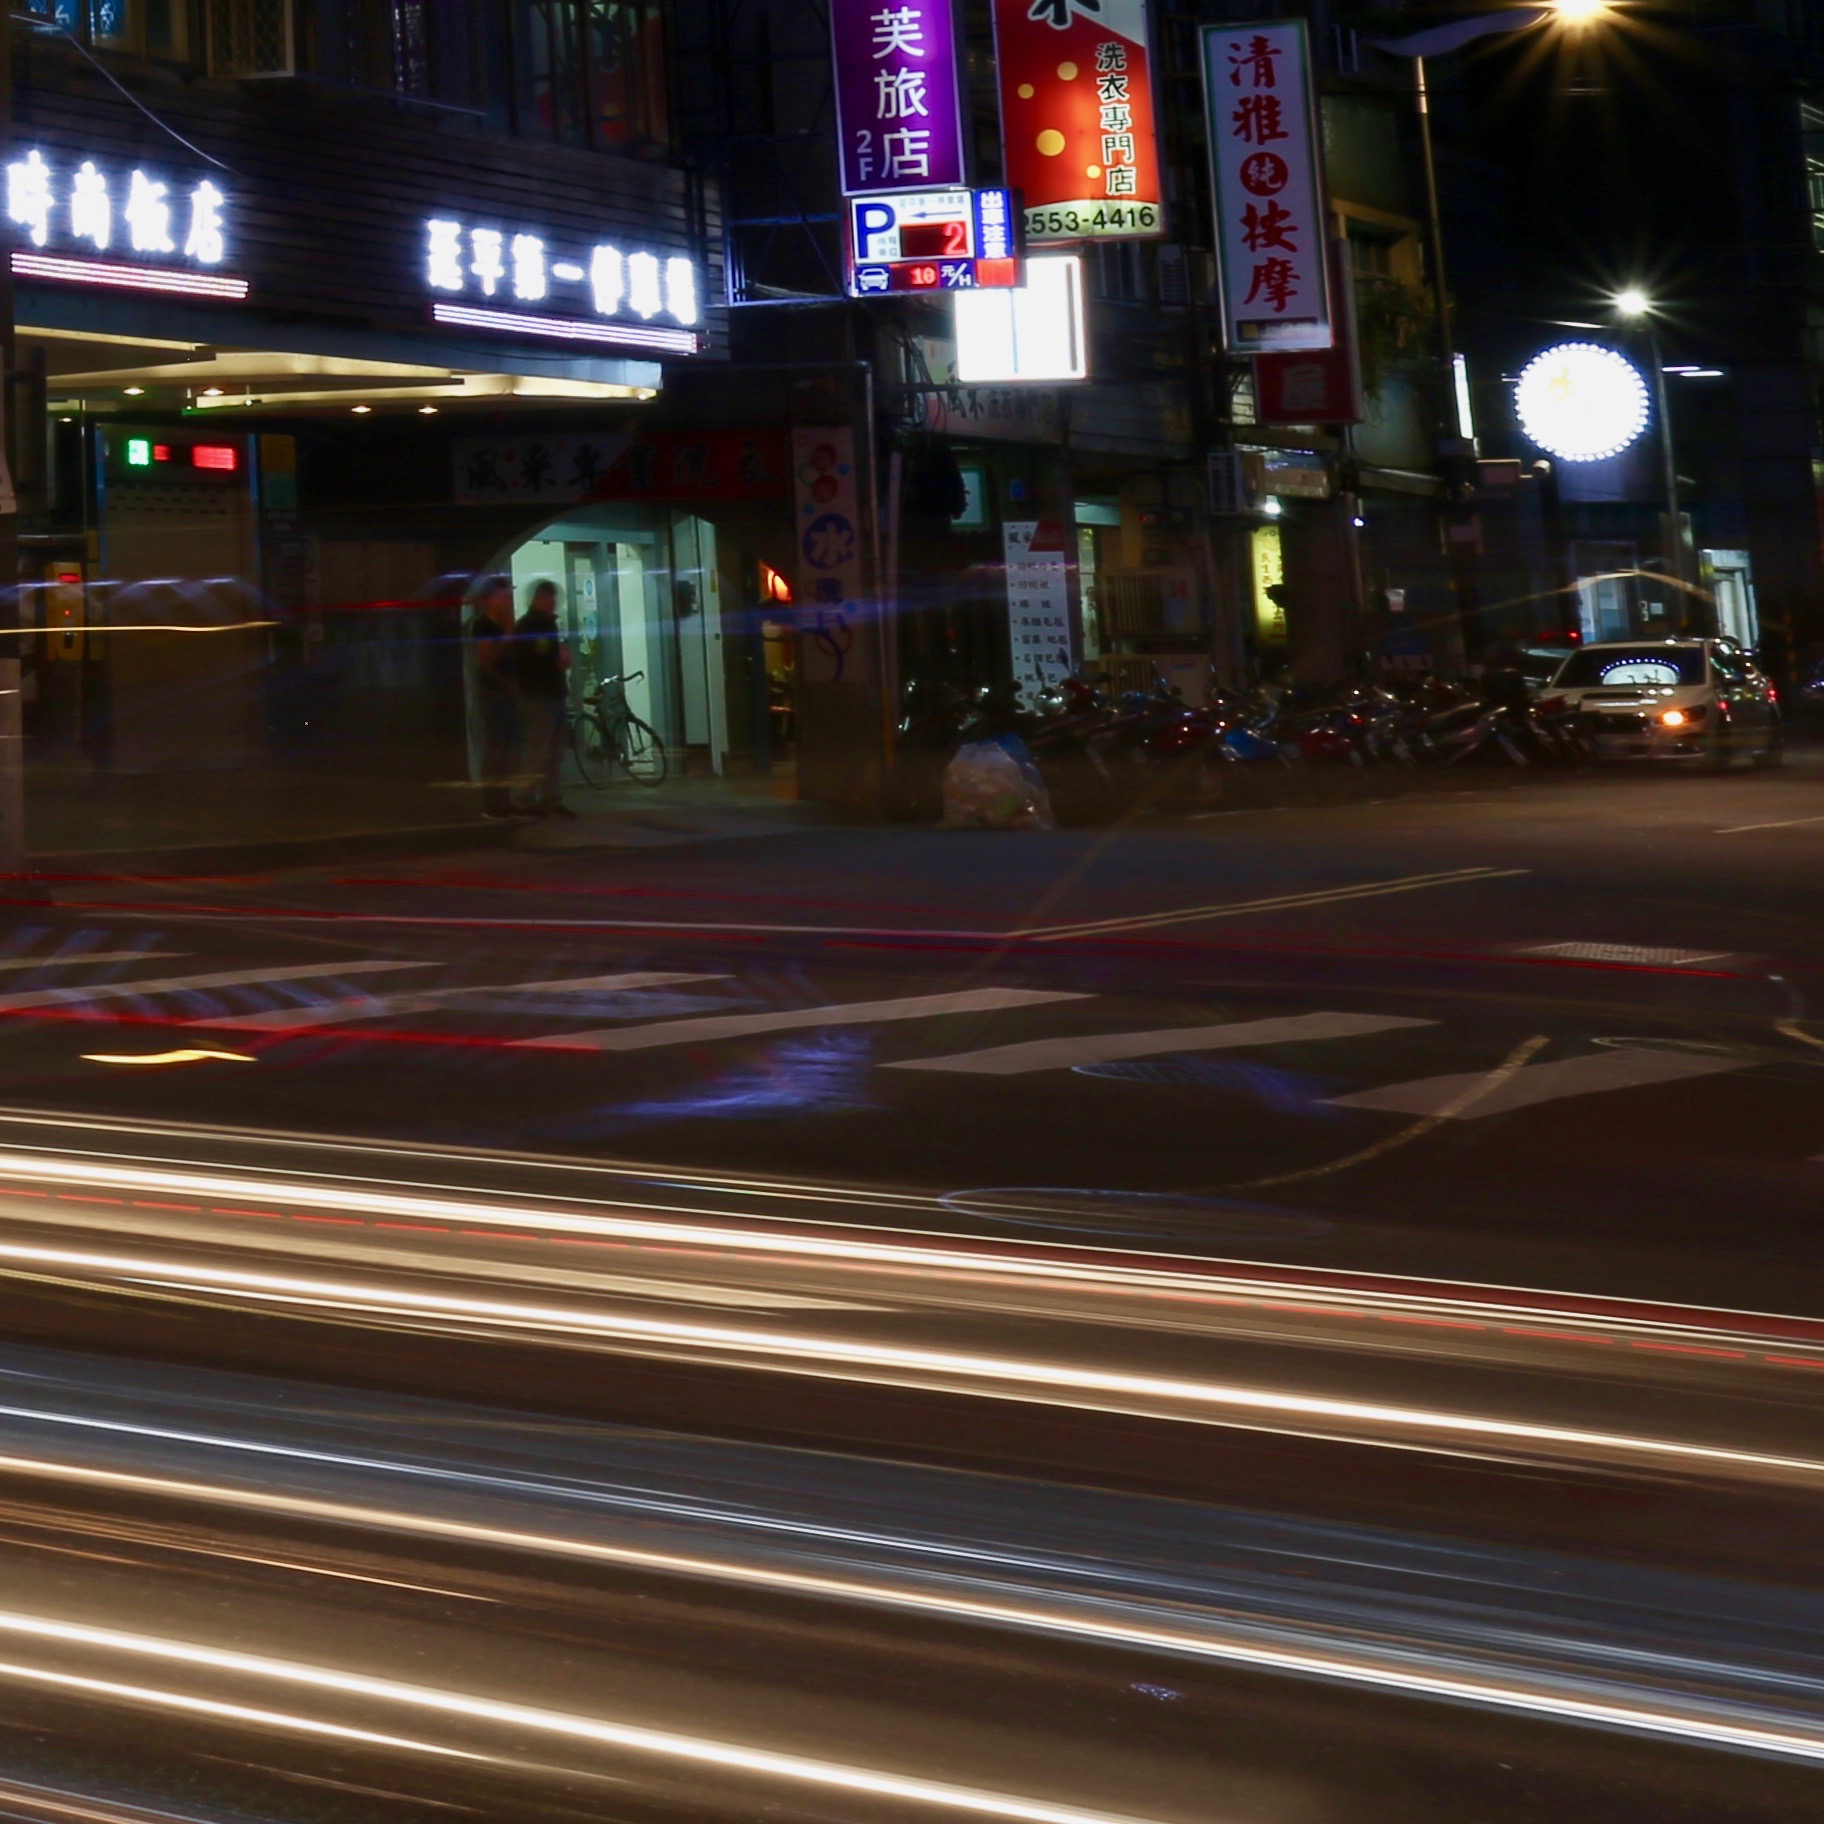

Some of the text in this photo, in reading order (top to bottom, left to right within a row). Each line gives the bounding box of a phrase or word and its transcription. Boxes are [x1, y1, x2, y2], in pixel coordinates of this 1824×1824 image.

[1095, 41, 1138, 197] 洗衣專門店
[854, 202, 896, 259] P
[941, 221, 968, 256] 2
